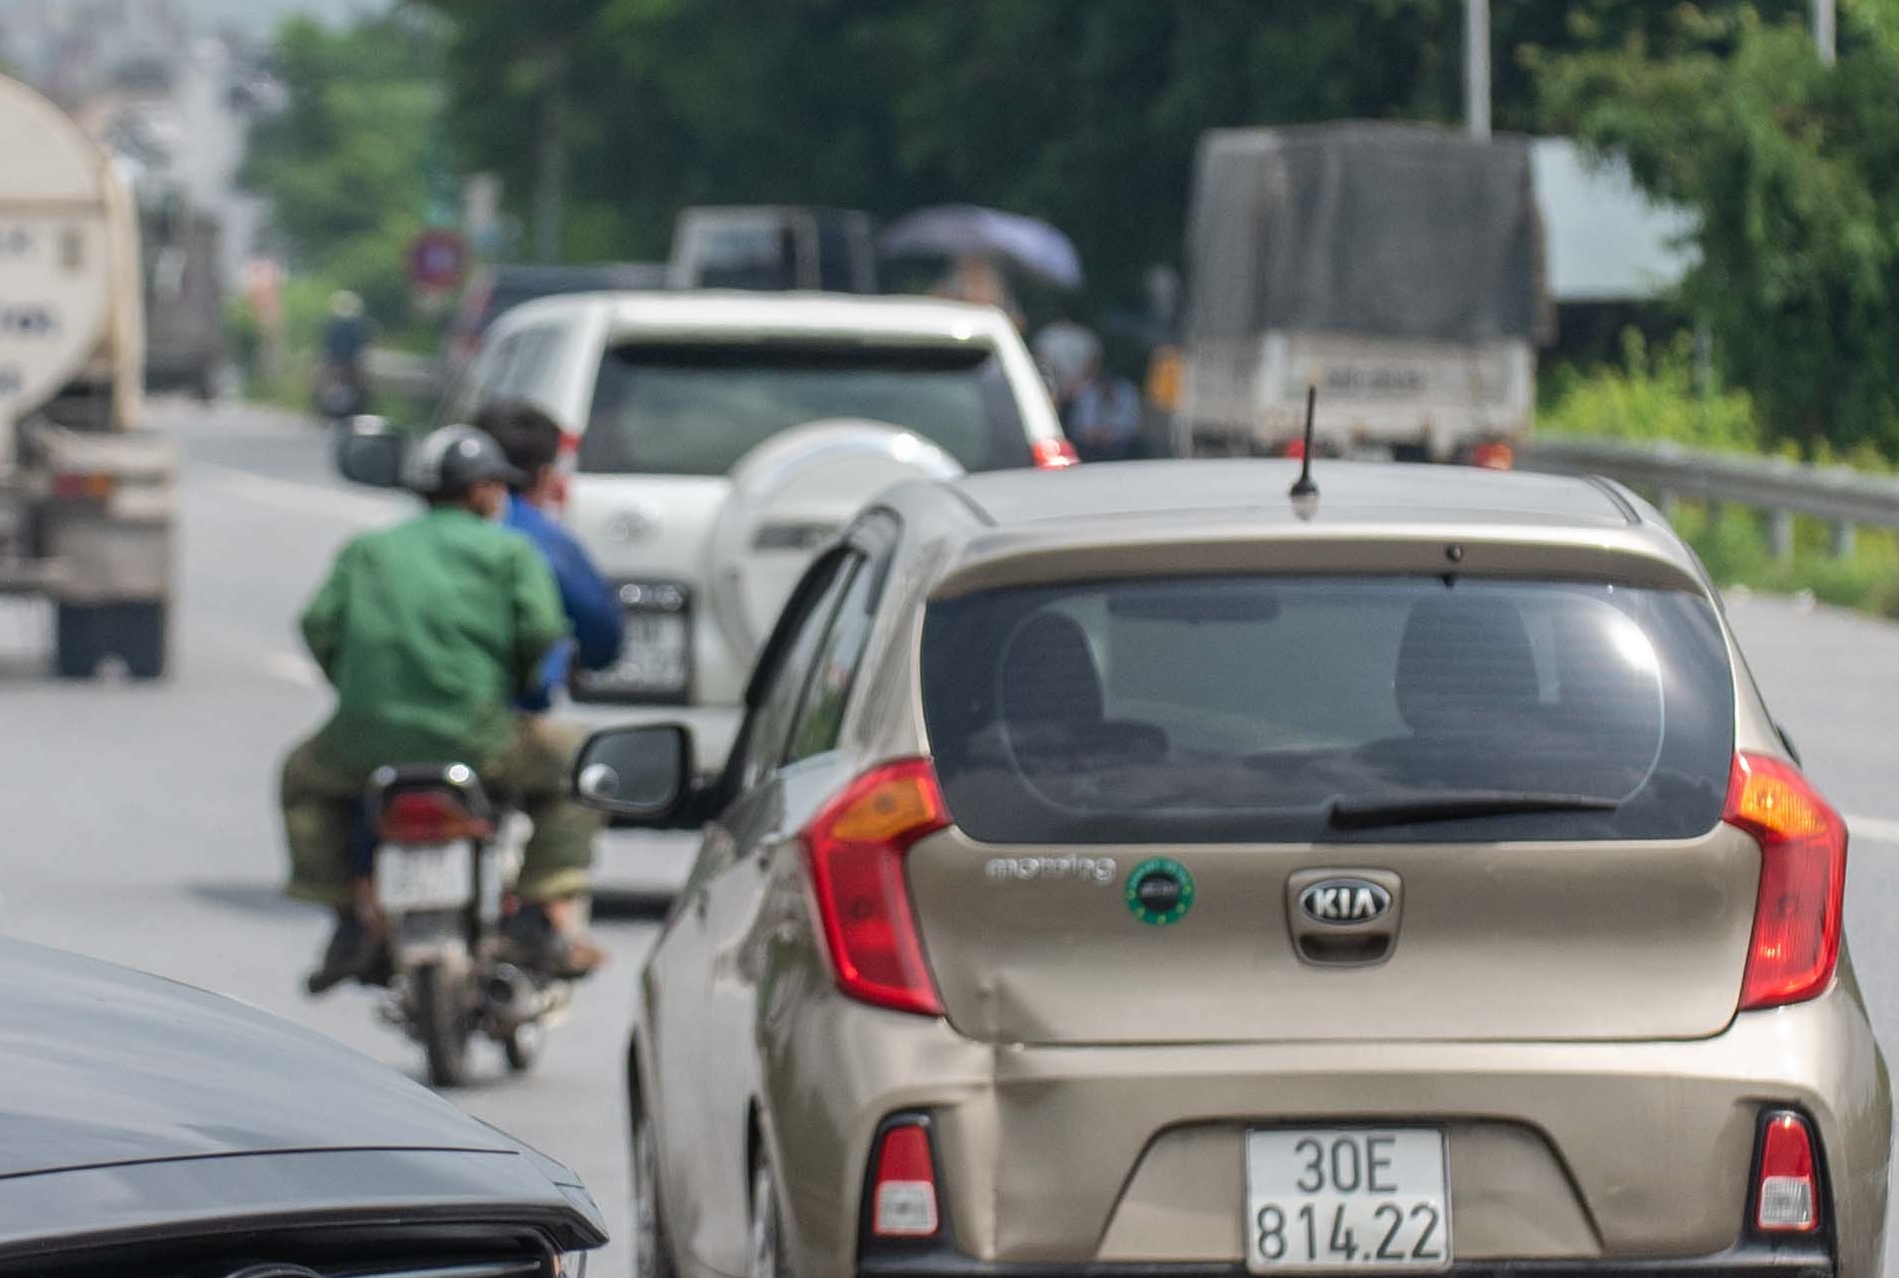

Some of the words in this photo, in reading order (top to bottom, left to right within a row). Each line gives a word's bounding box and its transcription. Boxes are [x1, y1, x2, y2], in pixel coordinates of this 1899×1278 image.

[985, 853, 1117, 888] morning
[1313, 887, 1376, 918] KIA
[1295, 1137, 1398, 1193] 30E
[1257, 1202, 1441, 1261] 814.22
